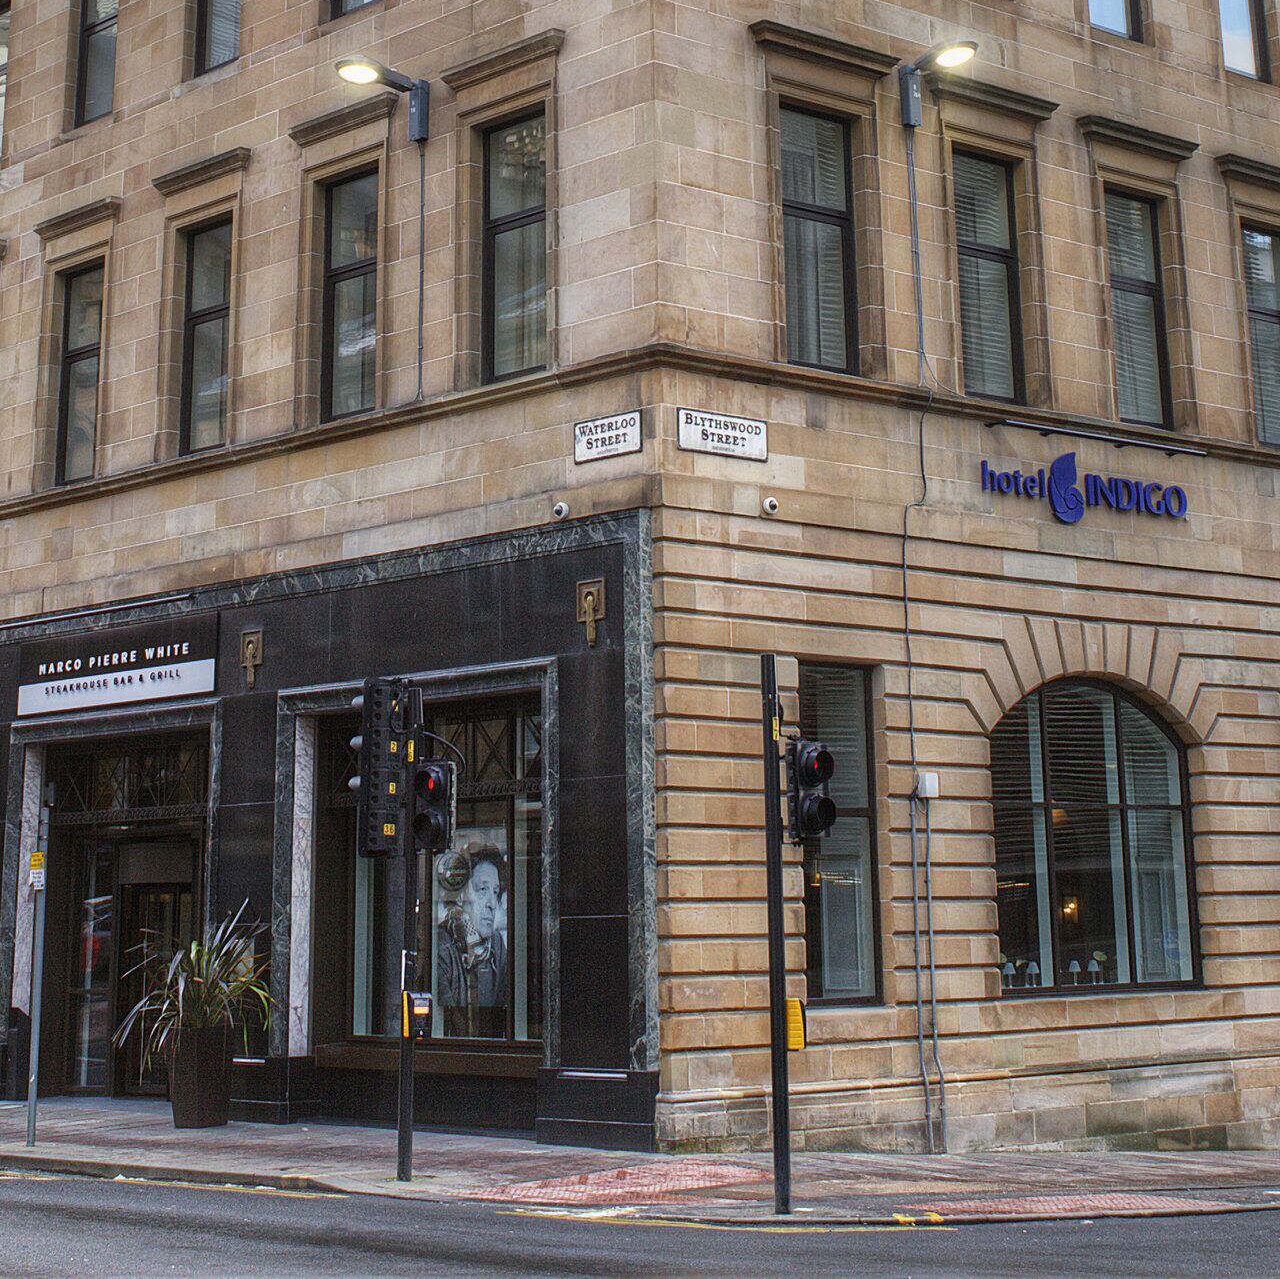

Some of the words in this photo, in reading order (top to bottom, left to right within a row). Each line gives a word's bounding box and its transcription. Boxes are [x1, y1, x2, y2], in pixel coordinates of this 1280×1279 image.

[578, 417, 636, 437] WATERLOO
[684, 412, 762, 436] BLYTHSWOOD
[586, 433, 629, 450] STREET
[701, 429, 747, 447] STREET
[981, 460, 1046, 498] hotel
[1085, 473, 1187, 518] INDIGO
[38, 658, 82, 676] MARCO
[88, 650, 138, 669] PIERRE
[144, 642, 190, 660] WHITE
[45, 678, 108, 696] STEAKHOUSE
[113, 675, 133, 687] BAR
[149, 669, 181, 682] GRILL
[384, 824, 394, 834] 36
